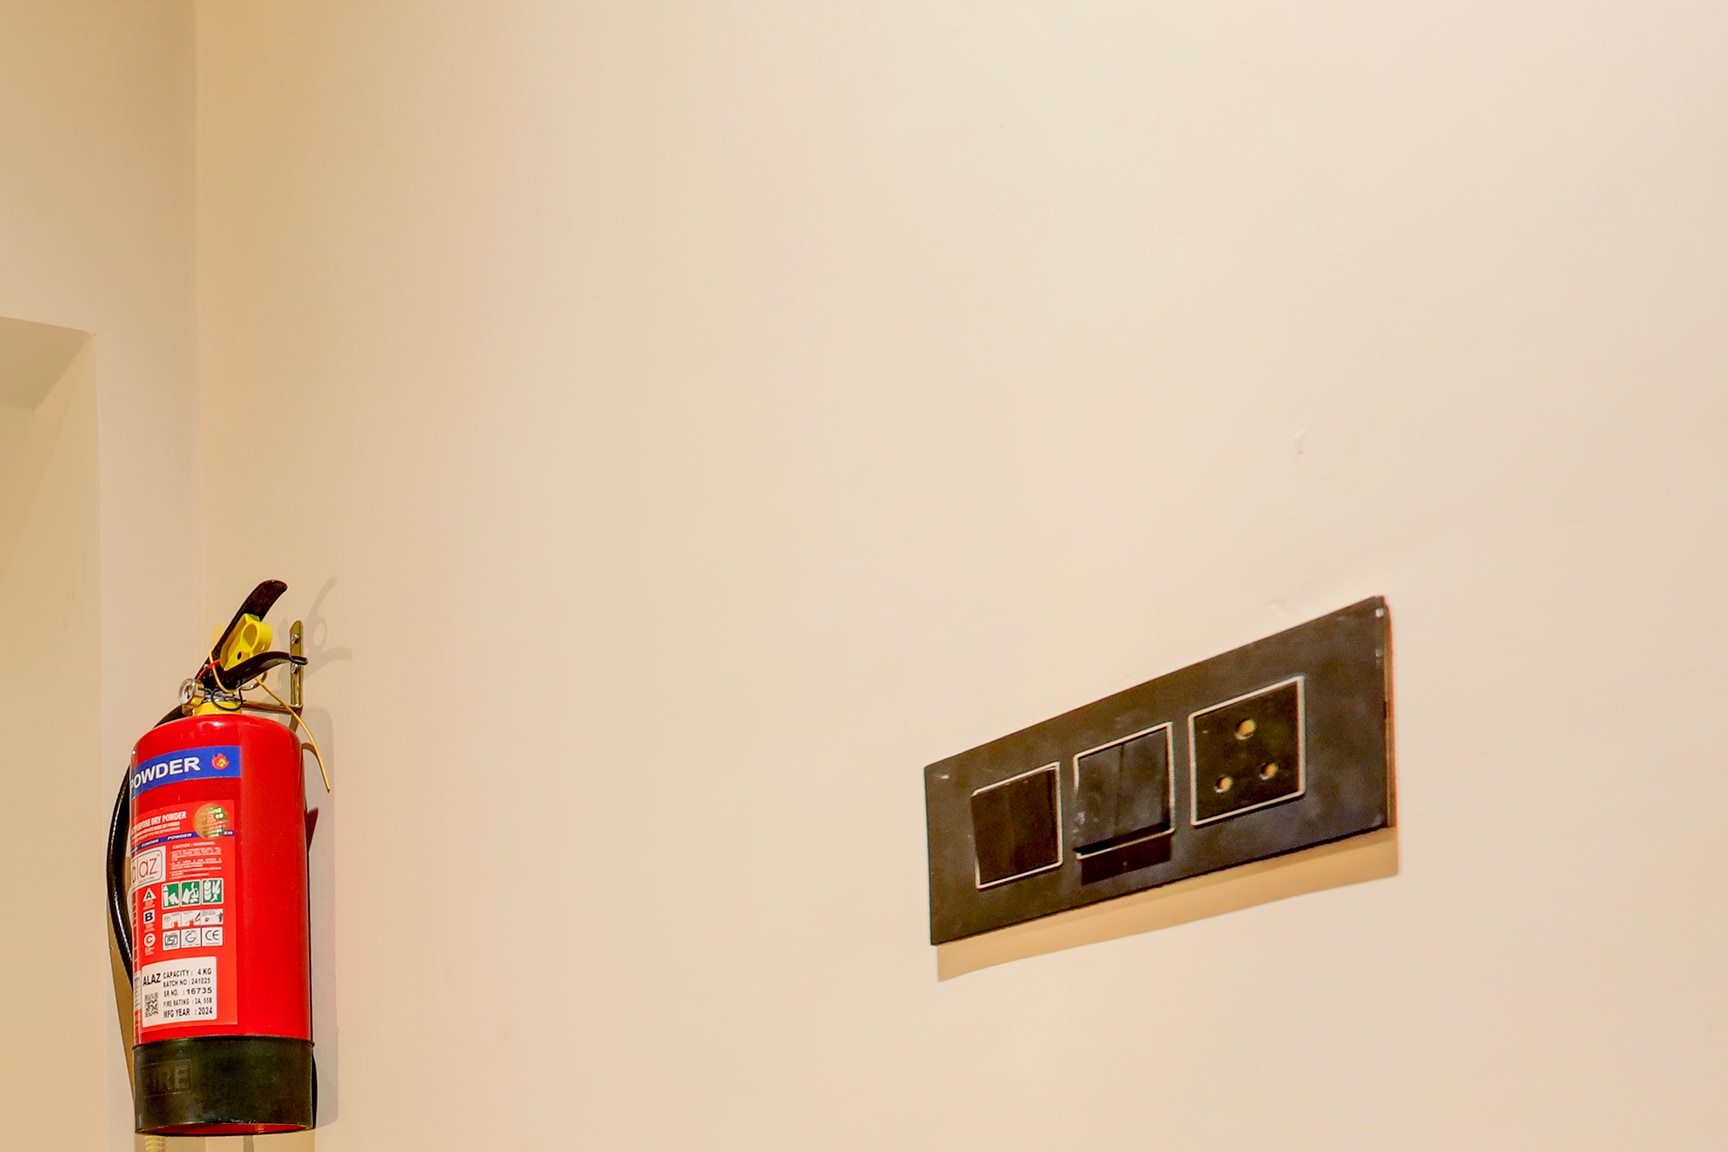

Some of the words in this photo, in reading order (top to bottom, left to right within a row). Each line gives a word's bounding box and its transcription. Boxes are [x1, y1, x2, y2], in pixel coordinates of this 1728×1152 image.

[162, 811, 187, 823] POWDER
[145, 891, 152, 899] A
[145, 912, 153, 922] B
[146, 935, 153, 944] C
[205, 929, 220, 941] CE
[143, 973, 161, 986] ALAZ
[163, 980, 178, 988] BATCH
[186, 987, 212, 995] 16735
[163, 1009, 174, 1018] MFG
[175, 1008, 191, 1016] YEAR
[198, 1006, 213, 1015] 2024
